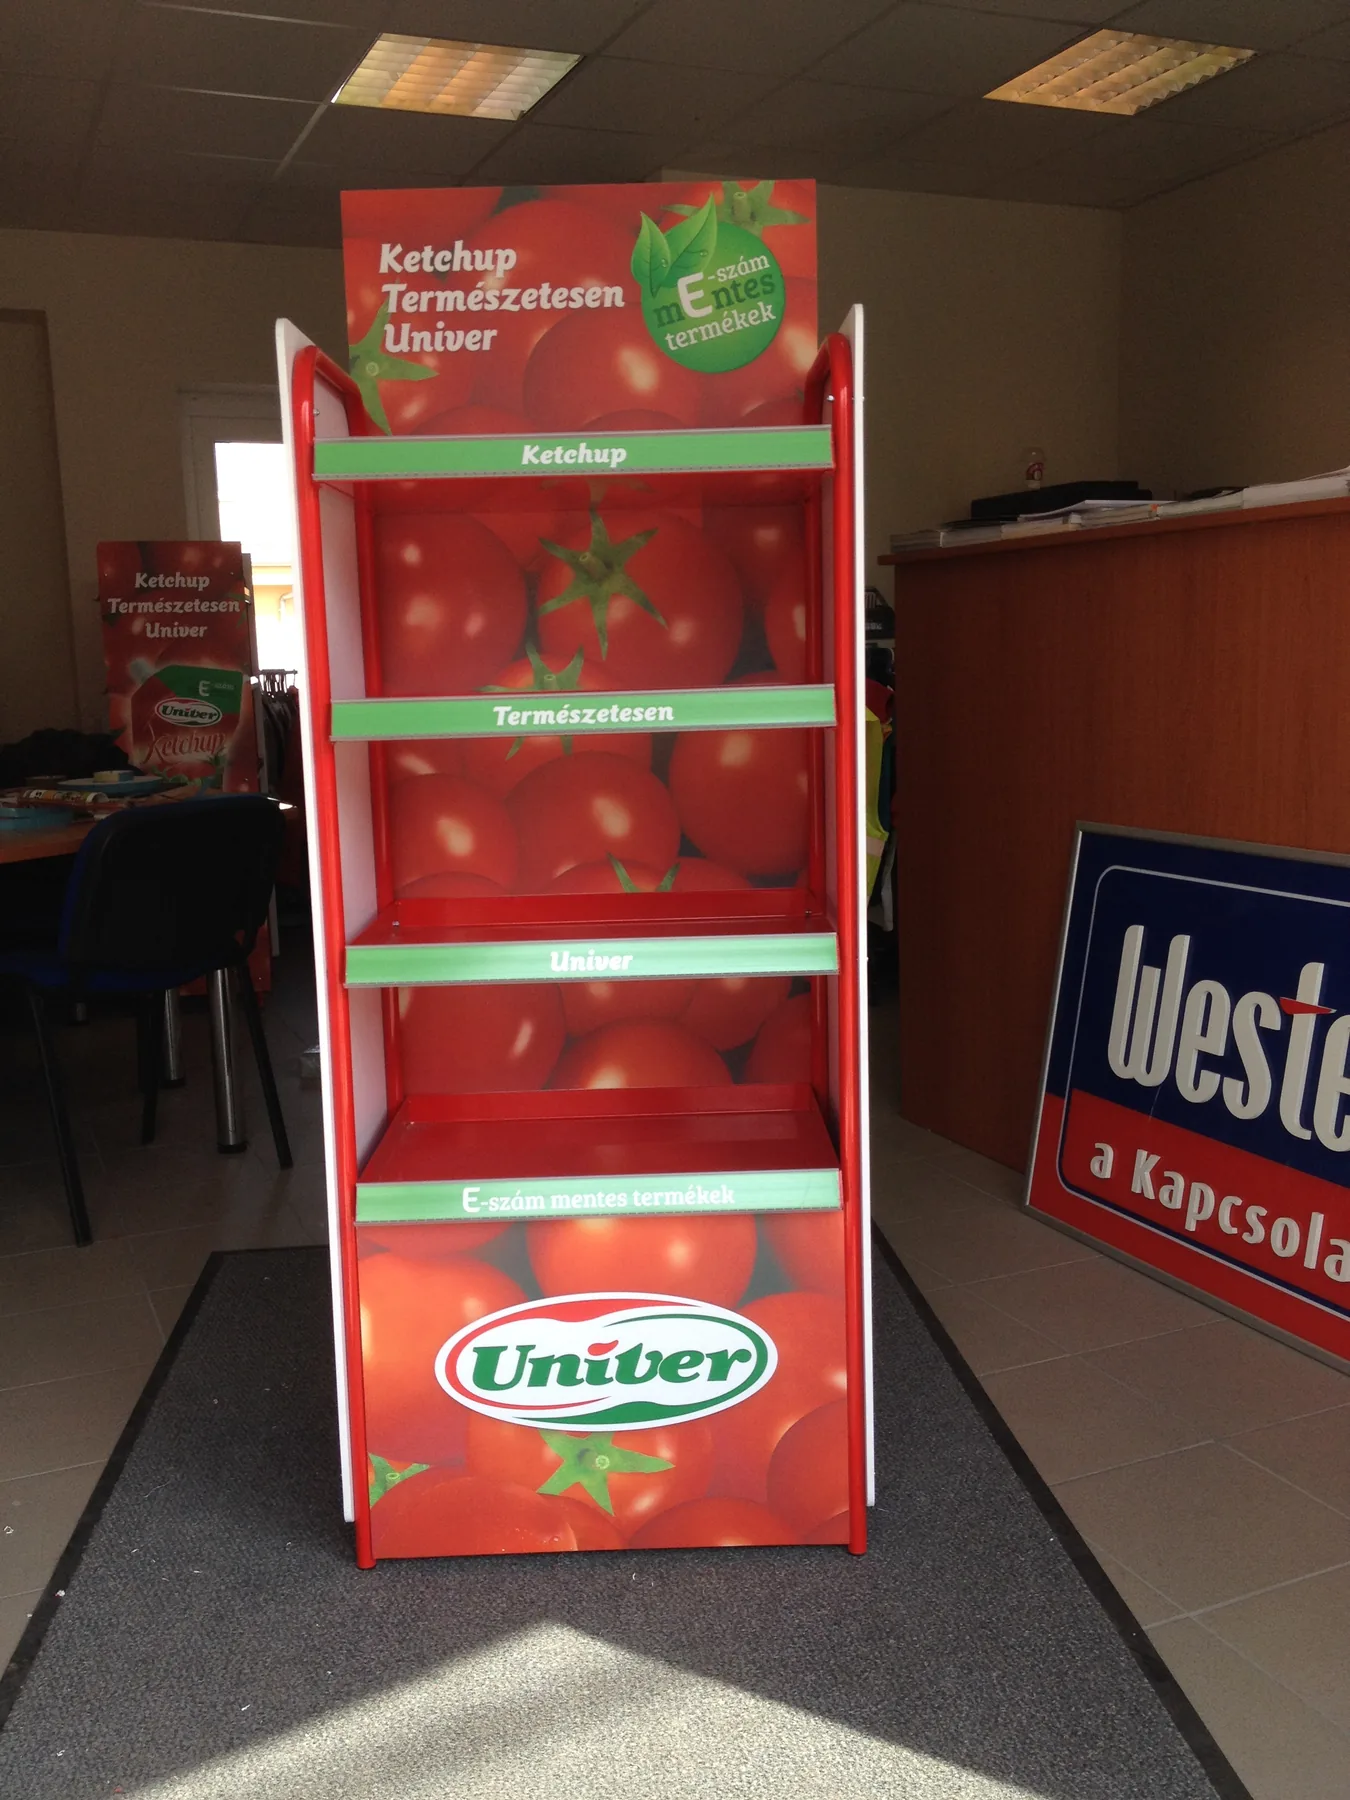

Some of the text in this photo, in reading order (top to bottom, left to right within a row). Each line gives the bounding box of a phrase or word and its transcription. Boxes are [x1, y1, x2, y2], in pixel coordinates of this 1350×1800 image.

[378, 240, 517, 278] Ketchup
[381, 282, 625, 313] Természetesen
[384, 321, 498, 353] Univer
[665, 301, 776, 351] termékek
[522, 443, 627, 468] Ketchup
[135, 572, 210, 591] Ketchup
[107, 595, 241, 614] Természetesen
[146, 621, 208, 638] Univer
[161, 705, 219, 720] Univer
[492, 704, 675, 726] Természetesen
[550, 949, 633, 972] Univer
[462, 1184, 736, 1213] E-szám mentes termékek
[1090, 1142, 1350, 1283] a Kapcsola
[472, 1340, 752, 1391] Univer
